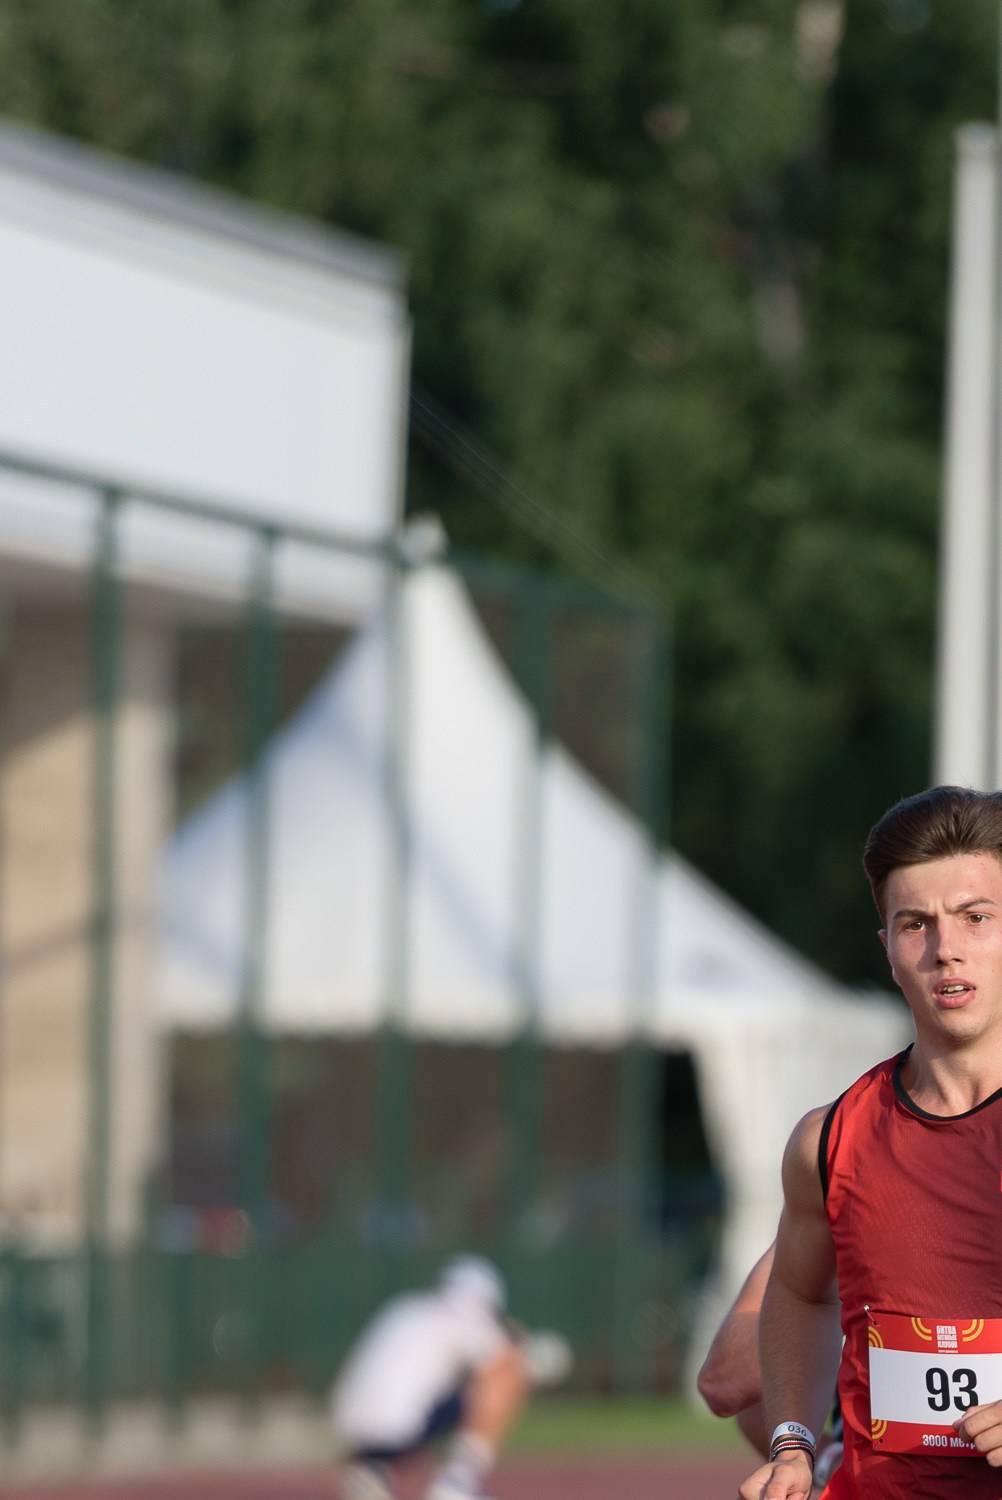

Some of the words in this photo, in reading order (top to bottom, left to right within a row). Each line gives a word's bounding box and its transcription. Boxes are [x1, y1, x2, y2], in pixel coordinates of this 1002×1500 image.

[925, 1367, 979, 1412] 93
[787, 1424, 807, 1437] 036
[922, 1434, 948, 1447] 3000
